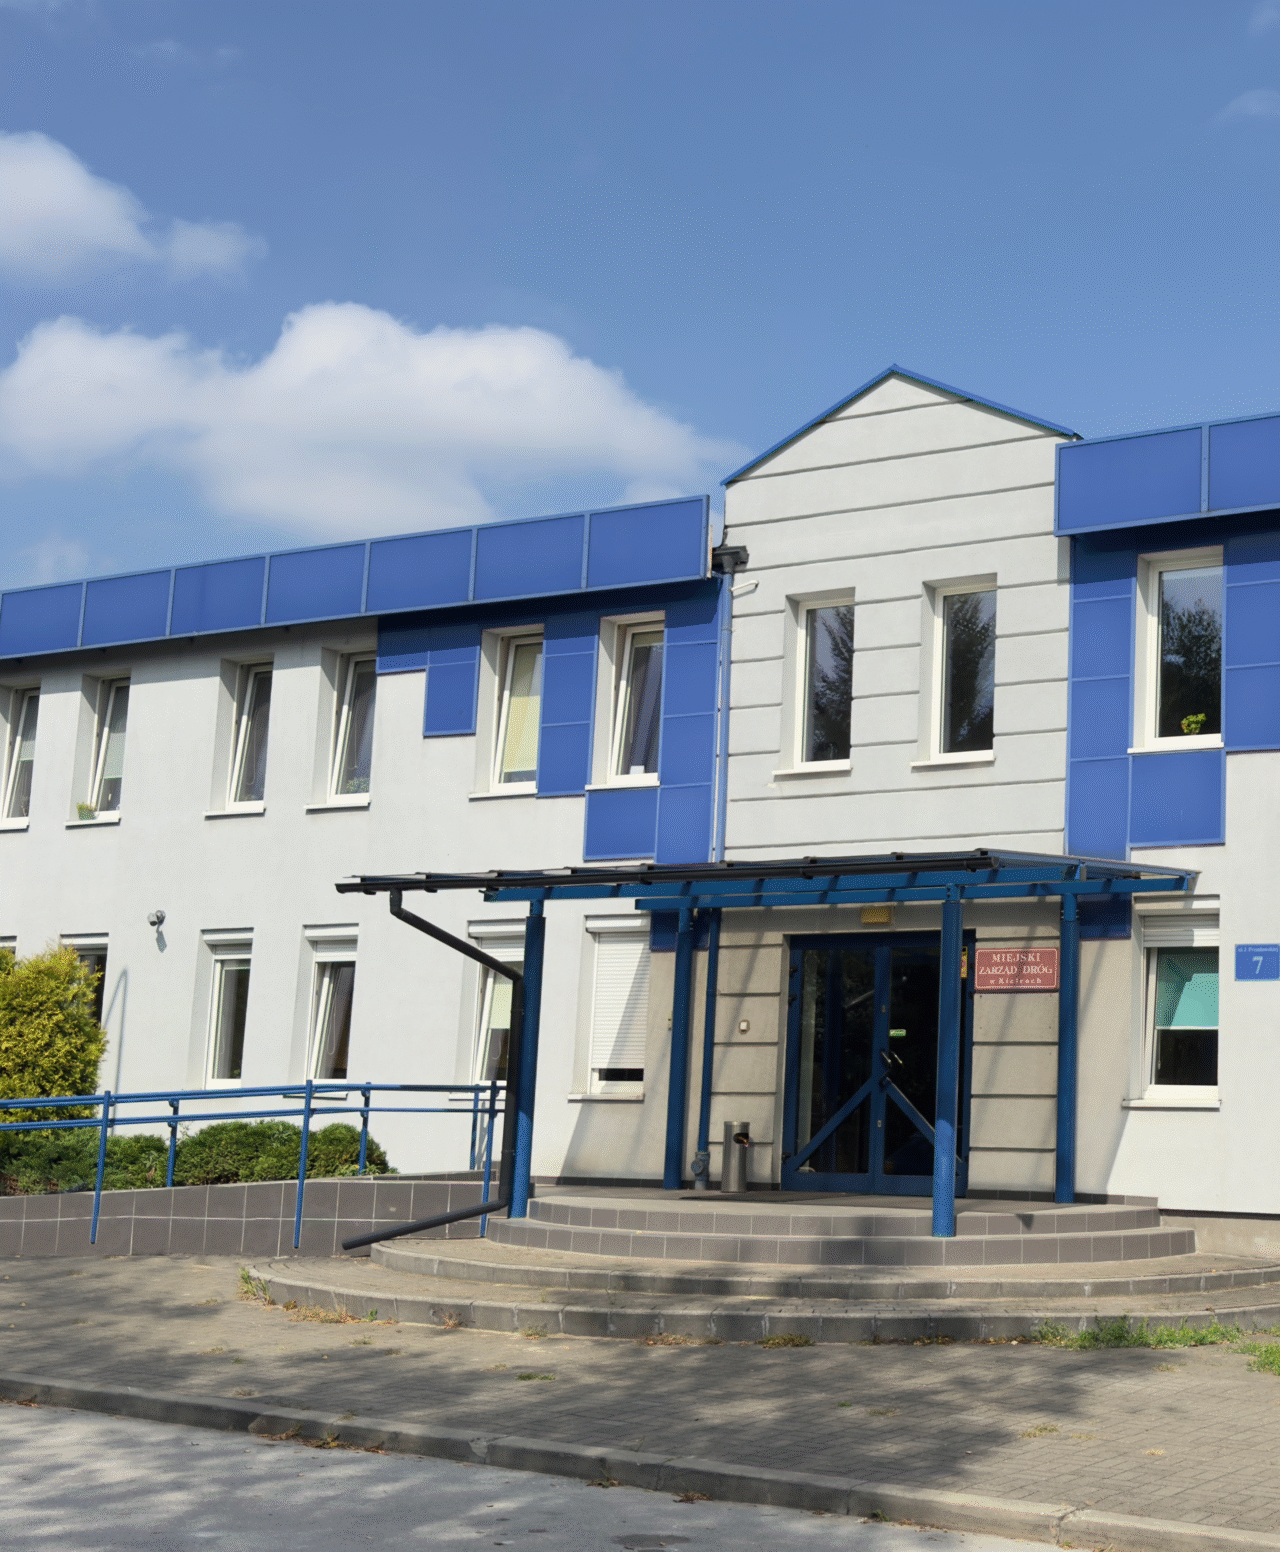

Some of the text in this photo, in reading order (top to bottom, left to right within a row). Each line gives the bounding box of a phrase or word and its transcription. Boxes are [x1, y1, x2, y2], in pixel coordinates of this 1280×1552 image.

[992, 953, 1041, 962] MIEJSKI
[1022, 964, 1053, 974] DRÓG
[1252, 956, 1263, 974] 7
